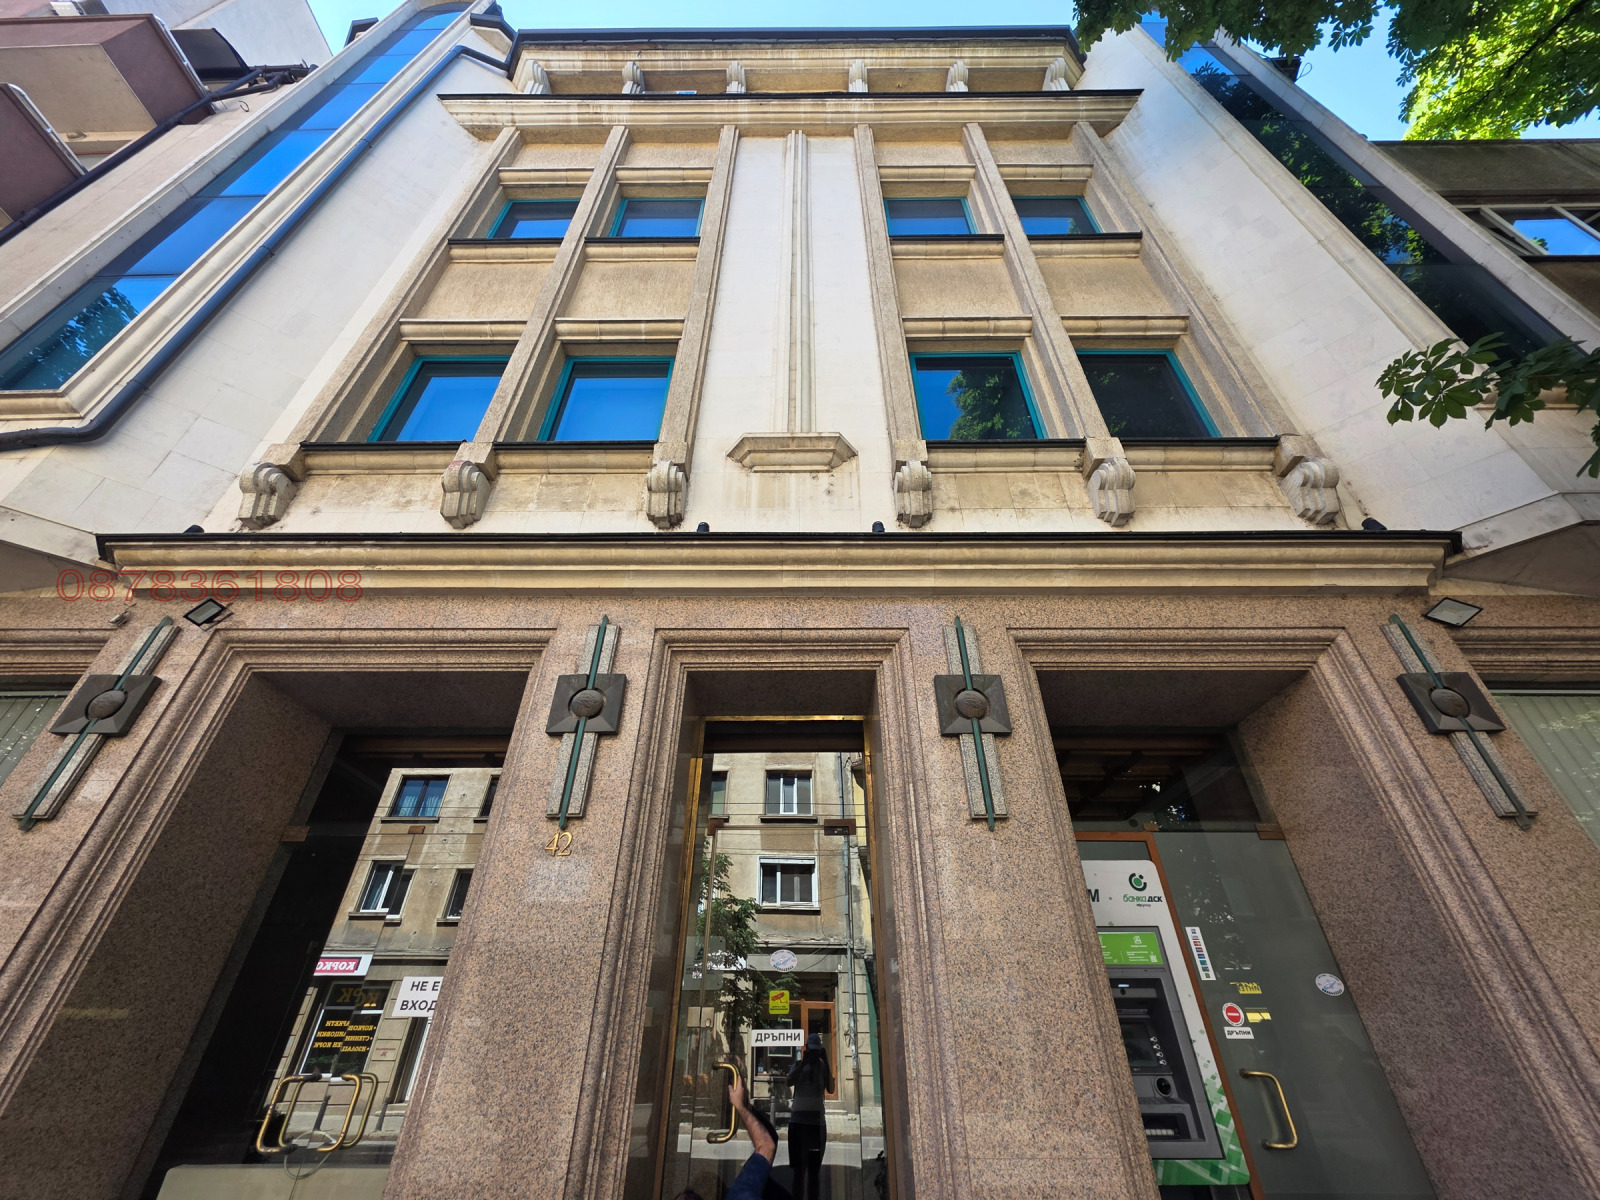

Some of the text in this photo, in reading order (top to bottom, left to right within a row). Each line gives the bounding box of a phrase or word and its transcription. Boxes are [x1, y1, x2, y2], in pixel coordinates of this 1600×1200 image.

[544, 831, 573, 857] 42
[1122, 894, 1147, 903] банка
[410, 981, 440, 991] НЕ Е
[399, 1000, 438, 1012] ВХОД
[754, 1032, 801, 1043] ДРЪПНИ
